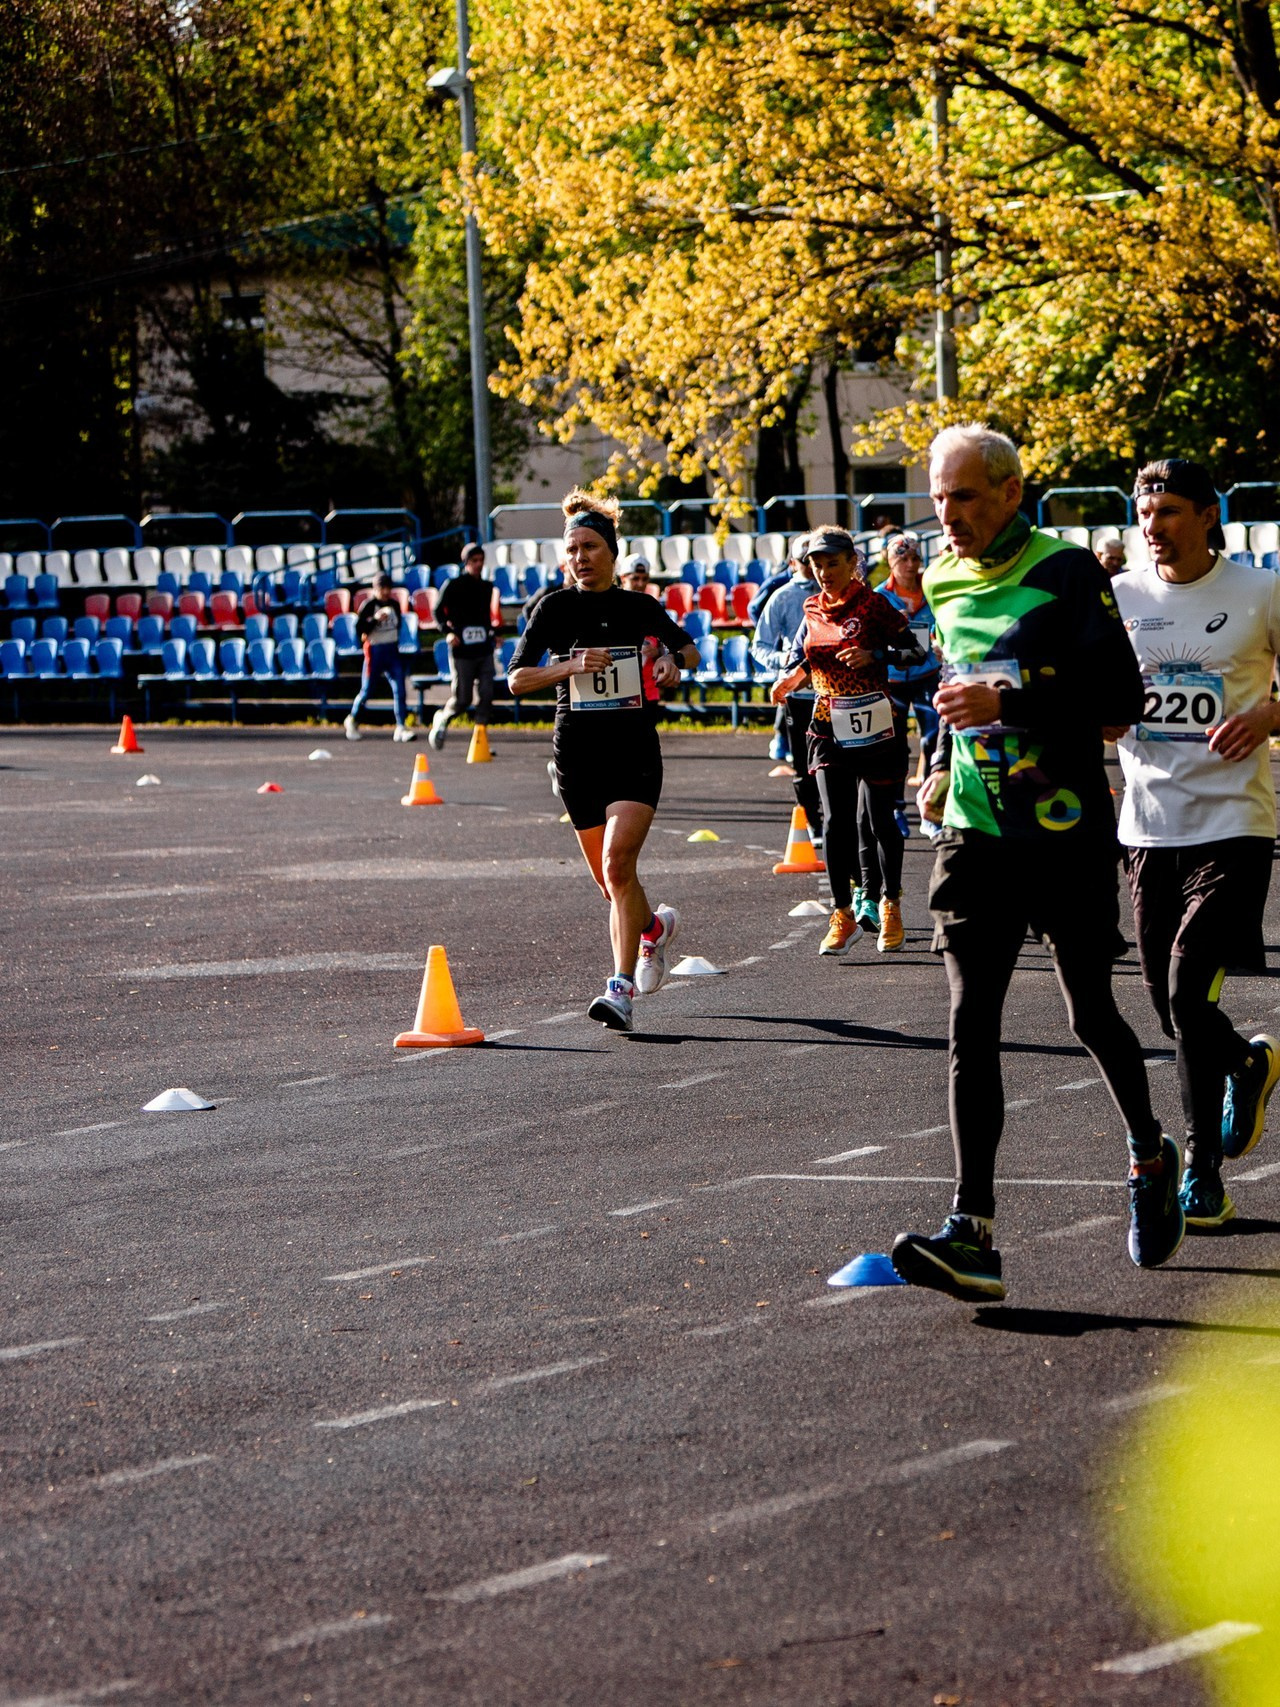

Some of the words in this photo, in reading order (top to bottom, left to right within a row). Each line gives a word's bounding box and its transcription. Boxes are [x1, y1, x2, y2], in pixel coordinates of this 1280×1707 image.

[592, 667, 619, 695] 61
[1141, 691, 1216, 725] 220
[849, 710, 873, 735] 57
